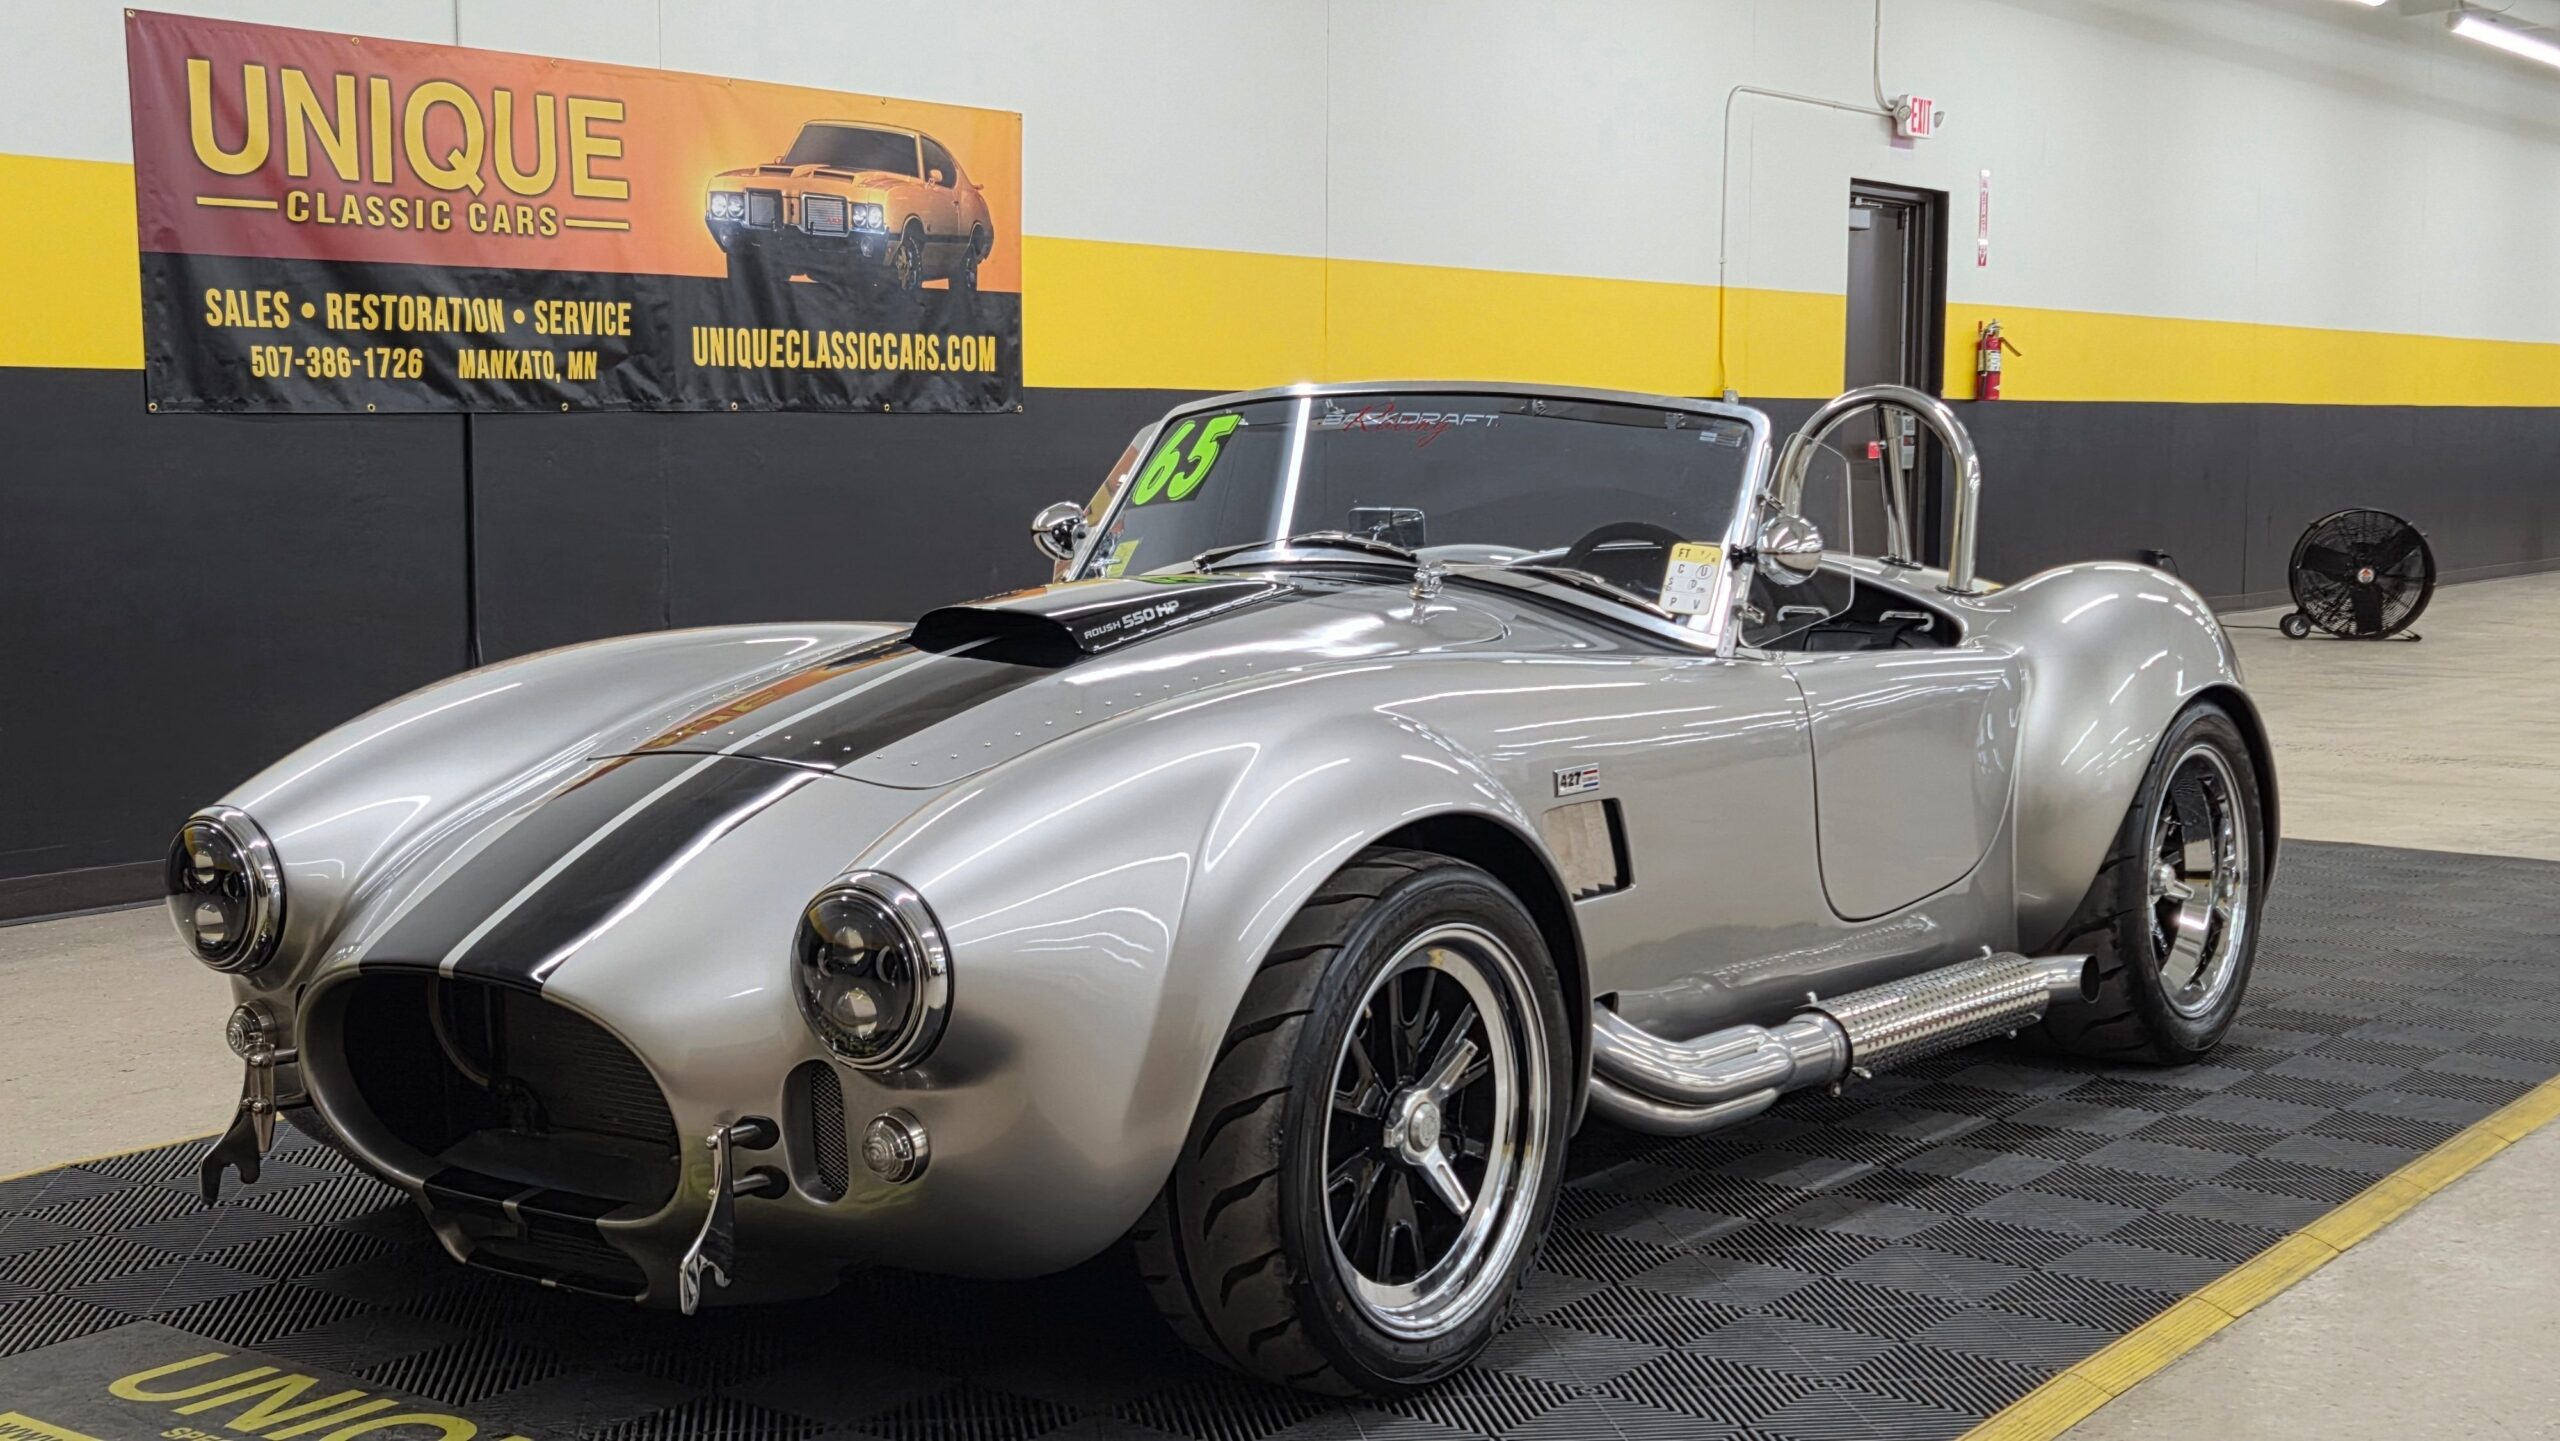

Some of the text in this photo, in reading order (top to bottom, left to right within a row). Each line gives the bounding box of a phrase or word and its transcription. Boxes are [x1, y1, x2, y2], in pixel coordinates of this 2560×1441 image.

[187, 58, 629, 199] UNIQUE
[1911, 97, 1932, 135] EXIT
[287, 191, 558, 236] CLASSIC CARS
[206, 288, 631, 336] SALES RESTORATION SERVICE
[251, 345, 598, 383] 507-386-1726 MANKATO, MN
[692, 326, 996, 372] UNIQUECLASSICCARS.COM
[1322, 412, 1499, 428] BACKDRAFT
[1132, 413, 1241, 506] 65
[1084, 600, 1179, 639] ROUSH 550 HP
